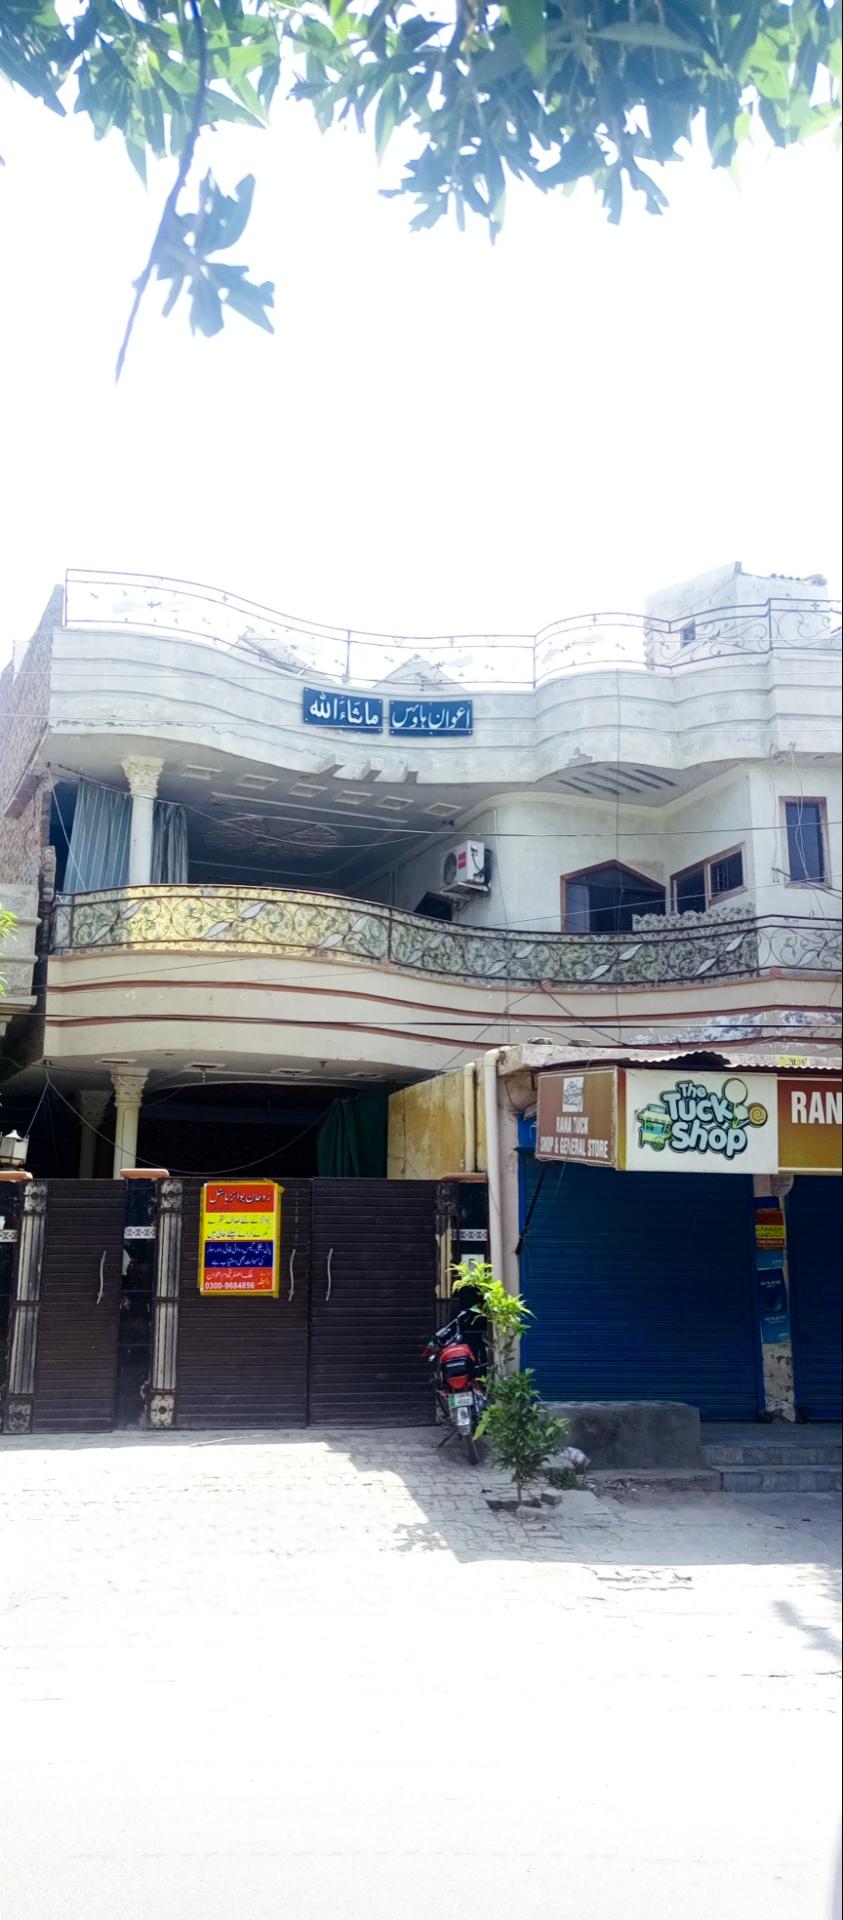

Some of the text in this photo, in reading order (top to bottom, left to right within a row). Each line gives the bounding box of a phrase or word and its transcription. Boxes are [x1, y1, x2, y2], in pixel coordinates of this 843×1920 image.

[429, 707, 470, 729] اعوان
[679, 1083, 707, 1099] The
[588, 1139, 608, 1158] STORE
